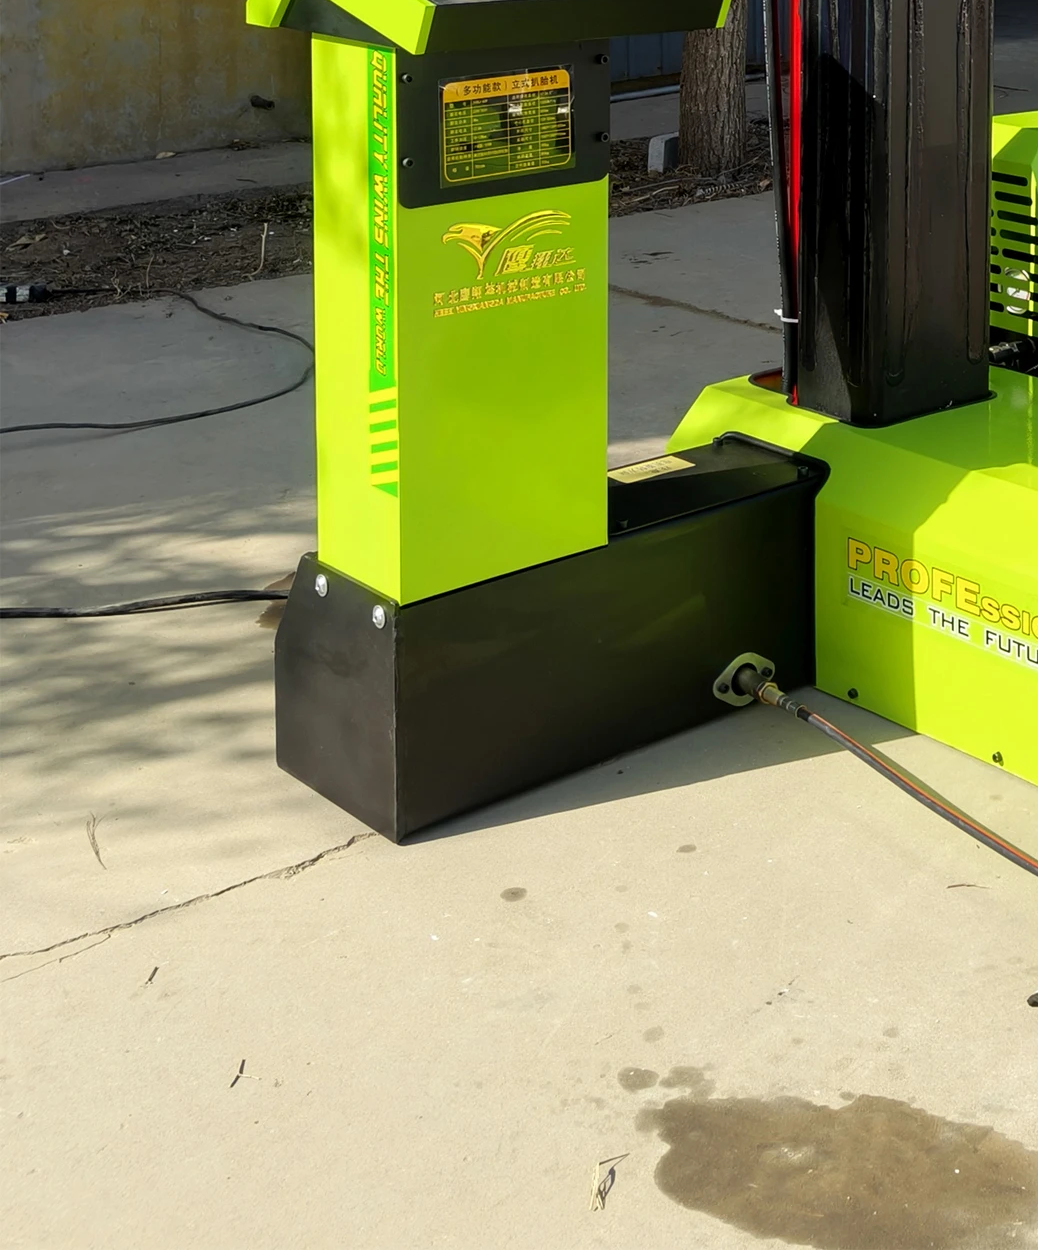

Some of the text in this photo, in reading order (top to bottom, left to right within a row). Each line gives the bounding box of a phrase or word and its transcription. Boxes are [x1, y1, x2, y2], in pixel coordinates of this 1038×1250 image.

[371, 50, 389, 377] QUALITY WINS THE WORLD
[849, 577, 914, 616] LEADS
[928, 607, 969, 637] THE
